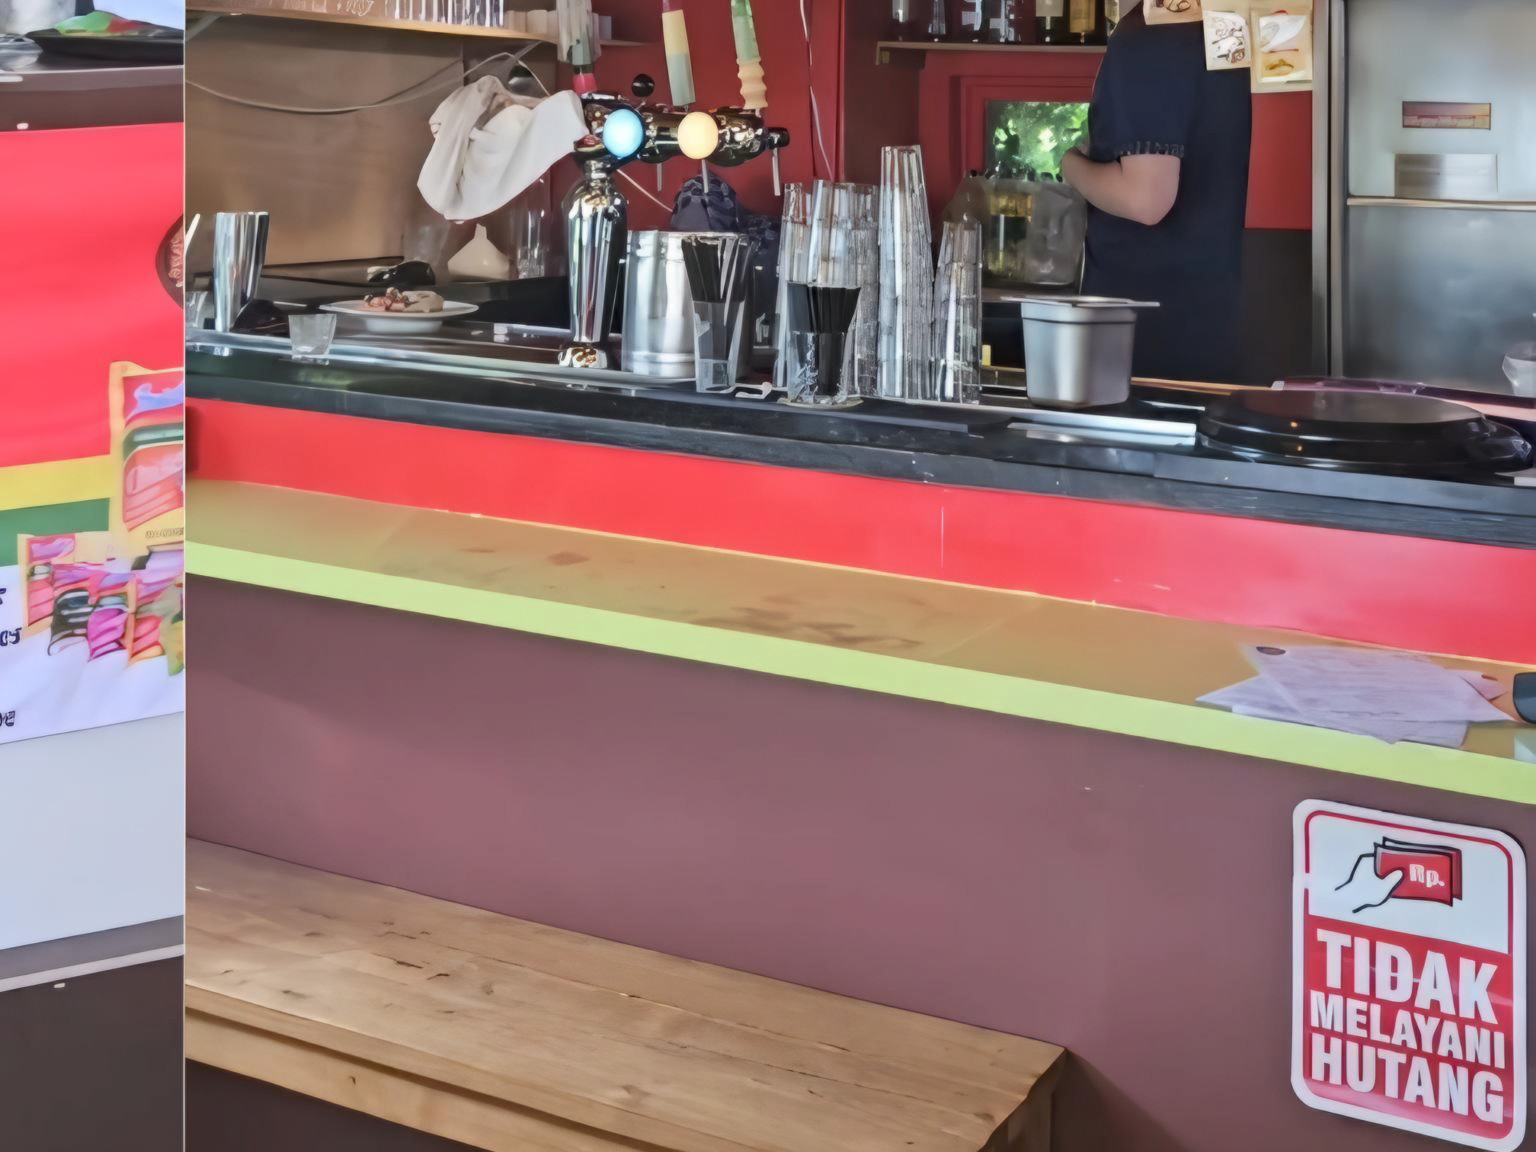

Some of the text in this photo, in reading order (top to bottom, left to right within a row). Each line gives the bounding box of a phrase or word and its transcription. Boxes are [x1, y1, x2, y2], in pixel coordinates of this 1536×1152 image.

[1317, 928, 1498, 1025] TIDAK
[1310, 990, 1505, 1070] MELAYANI
[1311, 1032, 1504, 1125] HUTANG
